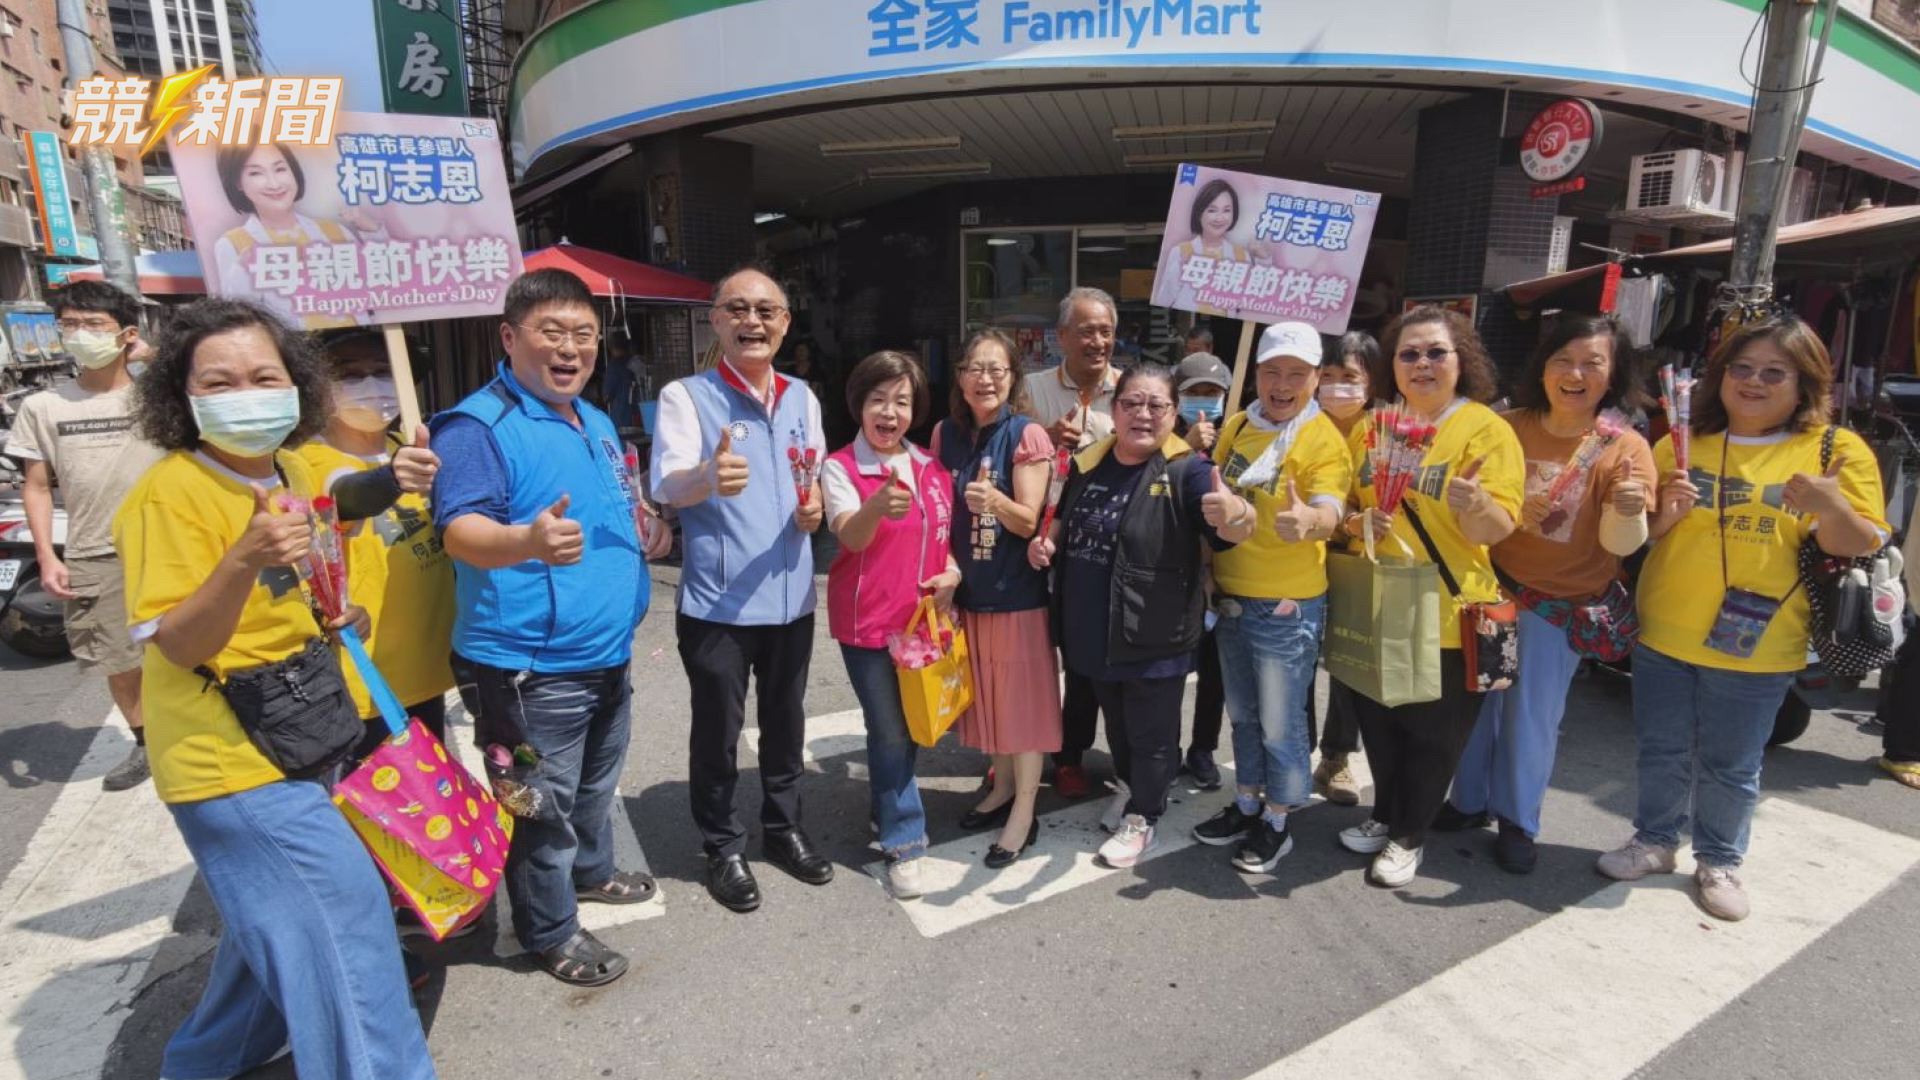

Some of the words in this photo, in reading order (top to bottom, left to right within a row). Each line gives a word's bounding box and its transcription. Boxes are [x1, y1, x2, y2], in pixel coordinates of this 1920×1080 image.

[868, 0, 980, 57] 全家
[1003, 0, 1261, 48] FamilyMart
[398, 0, 450, 98] 房
[339, 135, 473, 157] 高雄市長參選人
[339, 158, 482, 204] 柯志恩
[1257, 209, 1352, 250] 柯志恩
[1267, 193, 1354, 219] 高雄市長參選人
[249, 237, 511, 295] 母親節快樂
[1181, 255, 1349, 311] 母親節快樂
